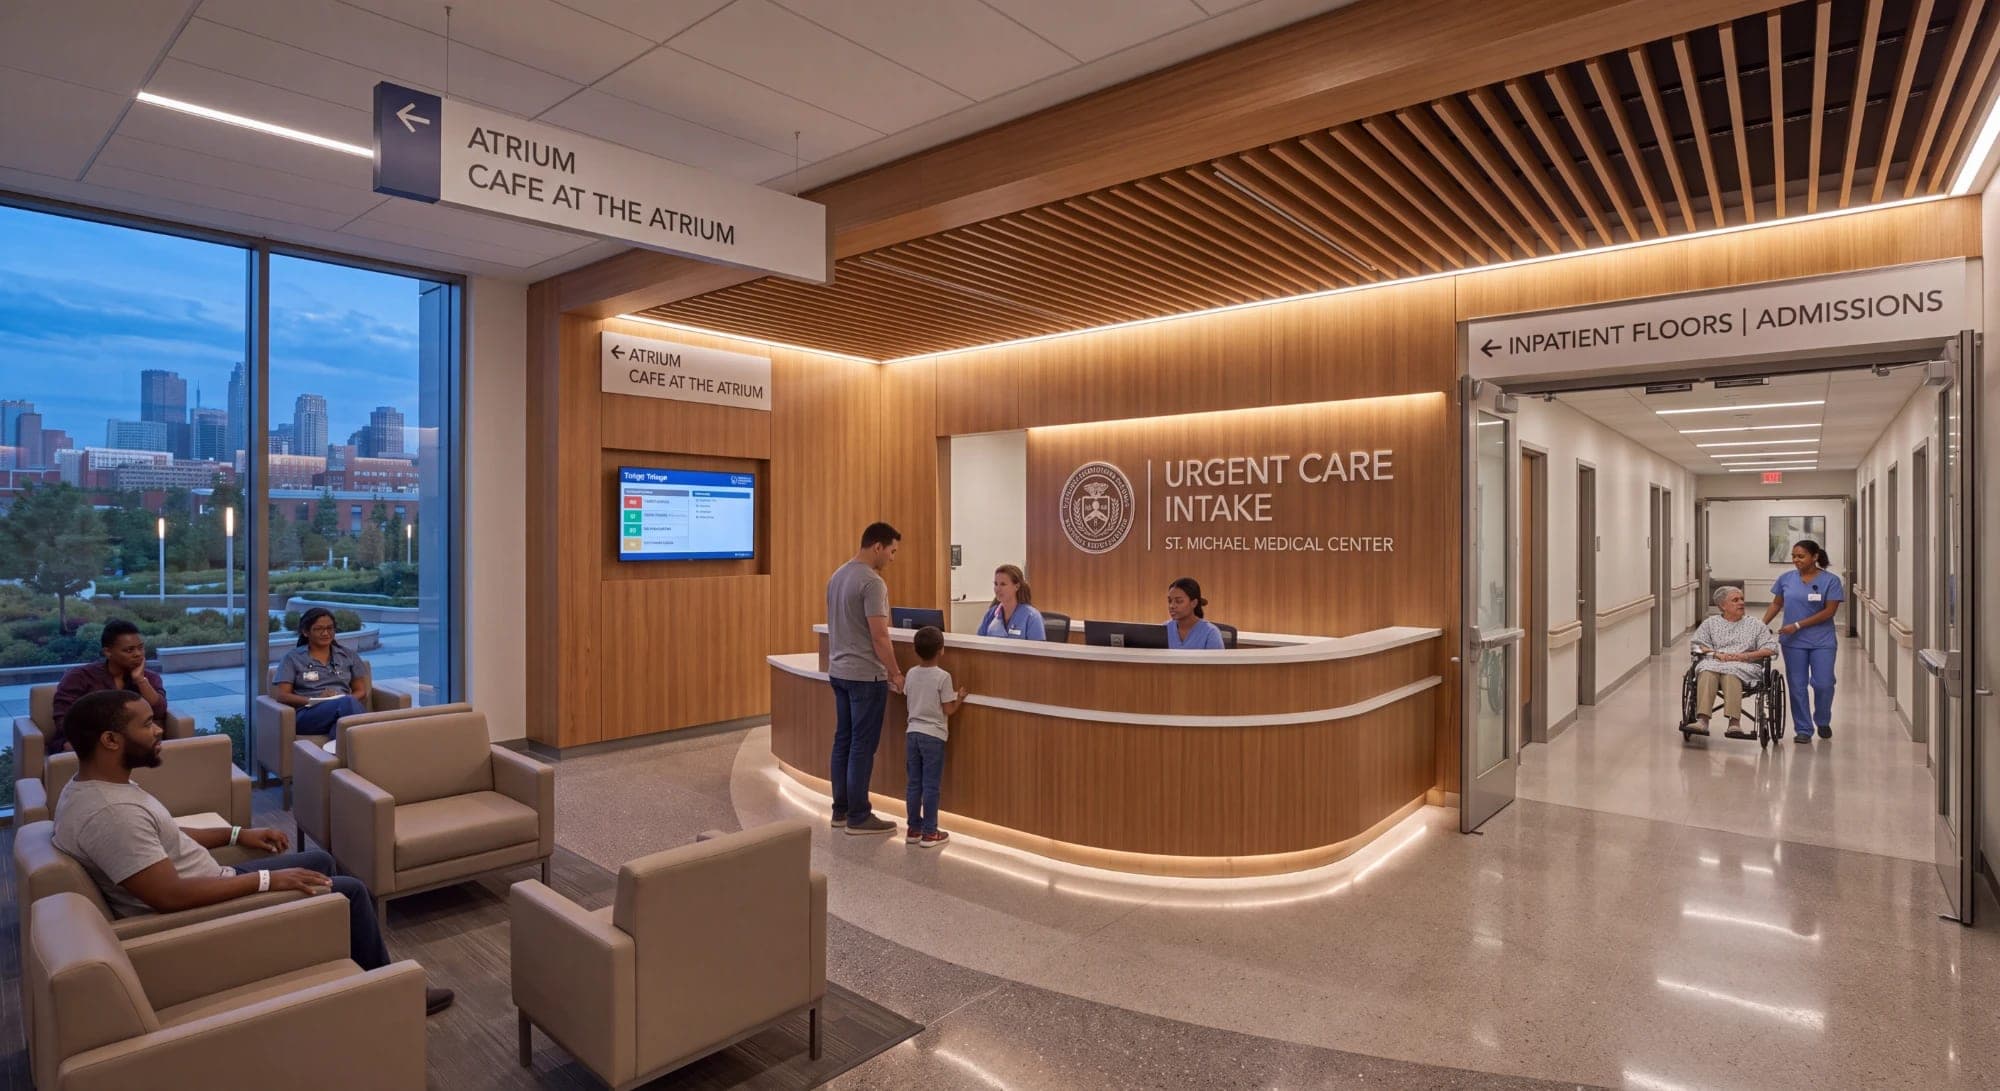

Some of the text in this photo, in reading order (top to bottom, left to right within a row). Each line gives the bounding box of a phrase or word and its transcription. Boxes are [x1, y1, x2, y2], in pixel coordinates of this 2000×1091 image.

[467, 126, 576, 175] ATRIUM
[468, 163, 736, 246] CAFE AT THE ATRIUM
[1508, 289, 1944, 355] INPATIENT FLOORS ADMISSIONS
[628, 347, 682, 369] ATRIUM
[628, 368, 764, 399] CAFE AT THE ATRIUM
[1164, 449, 1395, 488] URGENT CARE
[1164, 492, 1274, 523] INTAKE
[1164, 536, 1395, 553] ST. MICHAEL MEDICAL CENTER
